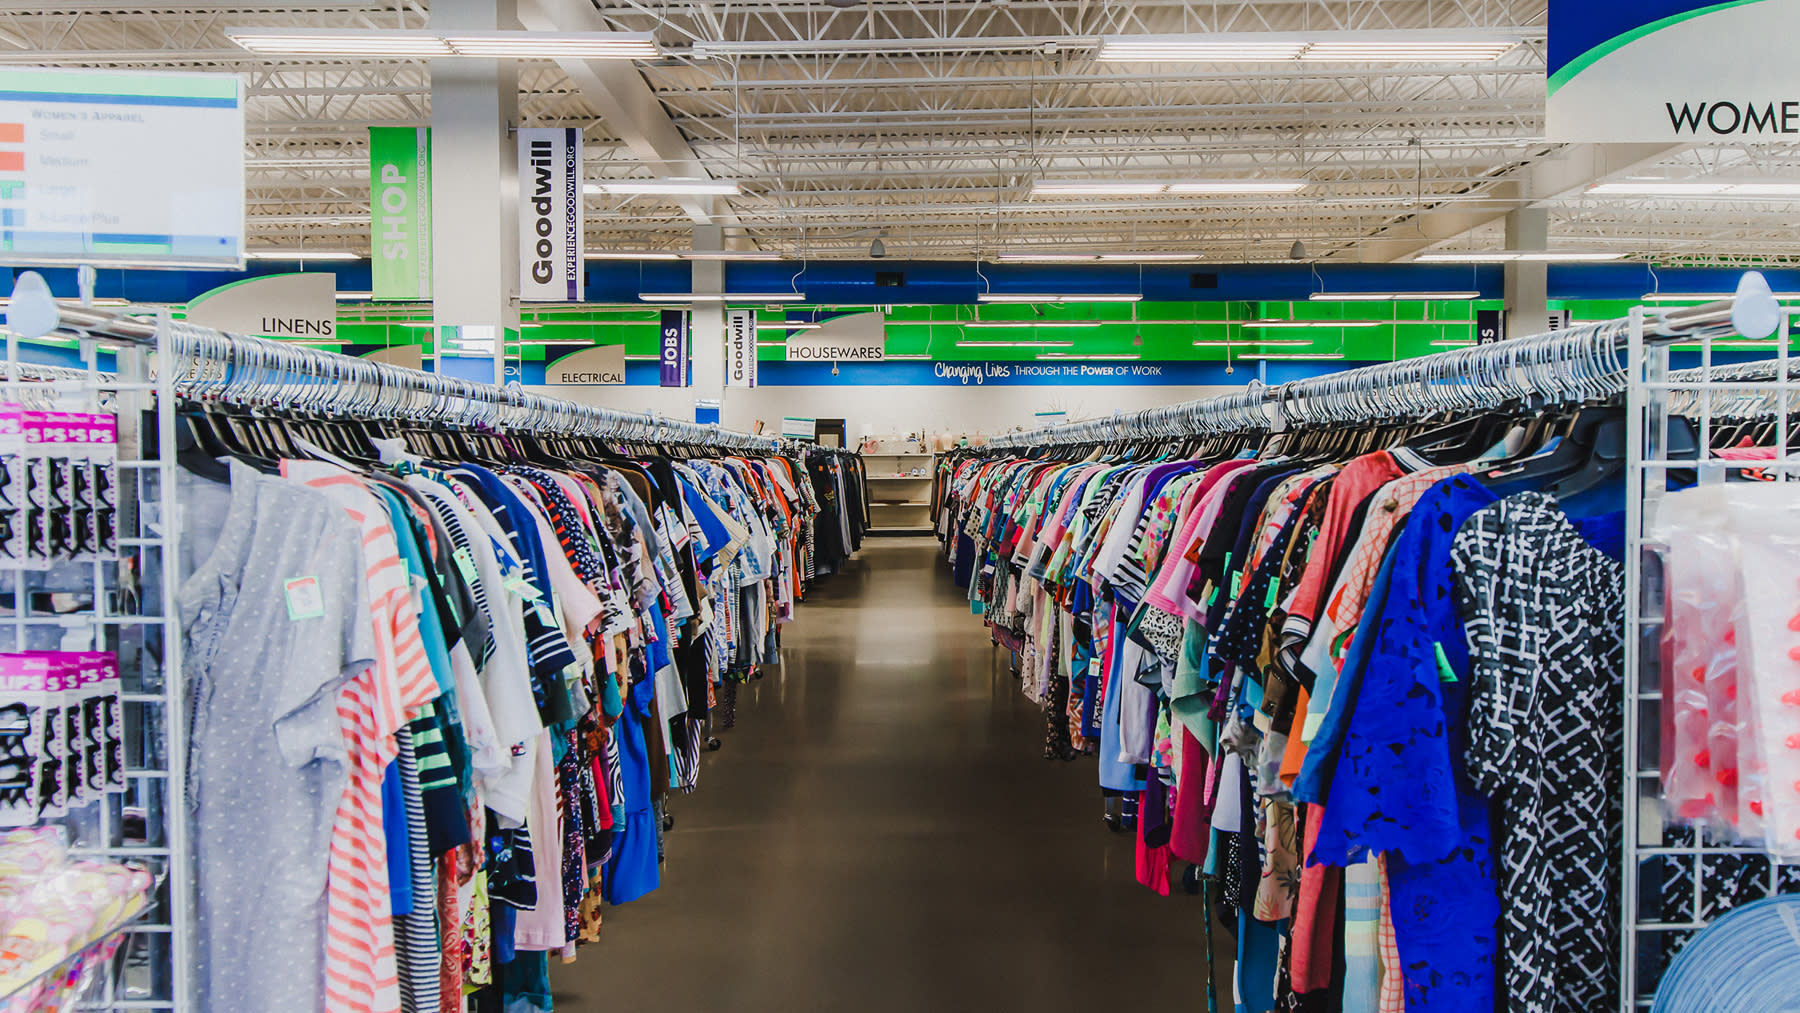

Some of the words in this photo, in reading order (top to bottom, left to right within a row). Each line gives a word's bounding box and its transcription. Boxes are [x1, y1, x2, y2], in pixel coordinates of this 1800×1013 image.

[92, 111, 145, 123] APPAREL
[380, 163, 408, 260] SHOP
[530, 140, 554, 285] Goodwill
[566, 145, 576, 281] EXPERIENCEGOODWILL.ORG
[262, 317, 333, 336] LINENS
[664, 327, 678, 369] JOBS
[733, 316, 743, 381] Goodwill
[789, 346, 882, 359] HOUSEWARES
[561, 372, 624, 384] ELECTRICAL
[934, 362, 983, 384] Changing
[985, 362, 1010, 378] Lives
[1014, 365, 1060, 376] THROUGH
[1062, 366, 1079, 376] THE
[1080, 365, 1114, 376] POWER
[1115, 366, 1129, 376] OF
[1131, 366, 1163, 376] WORK
